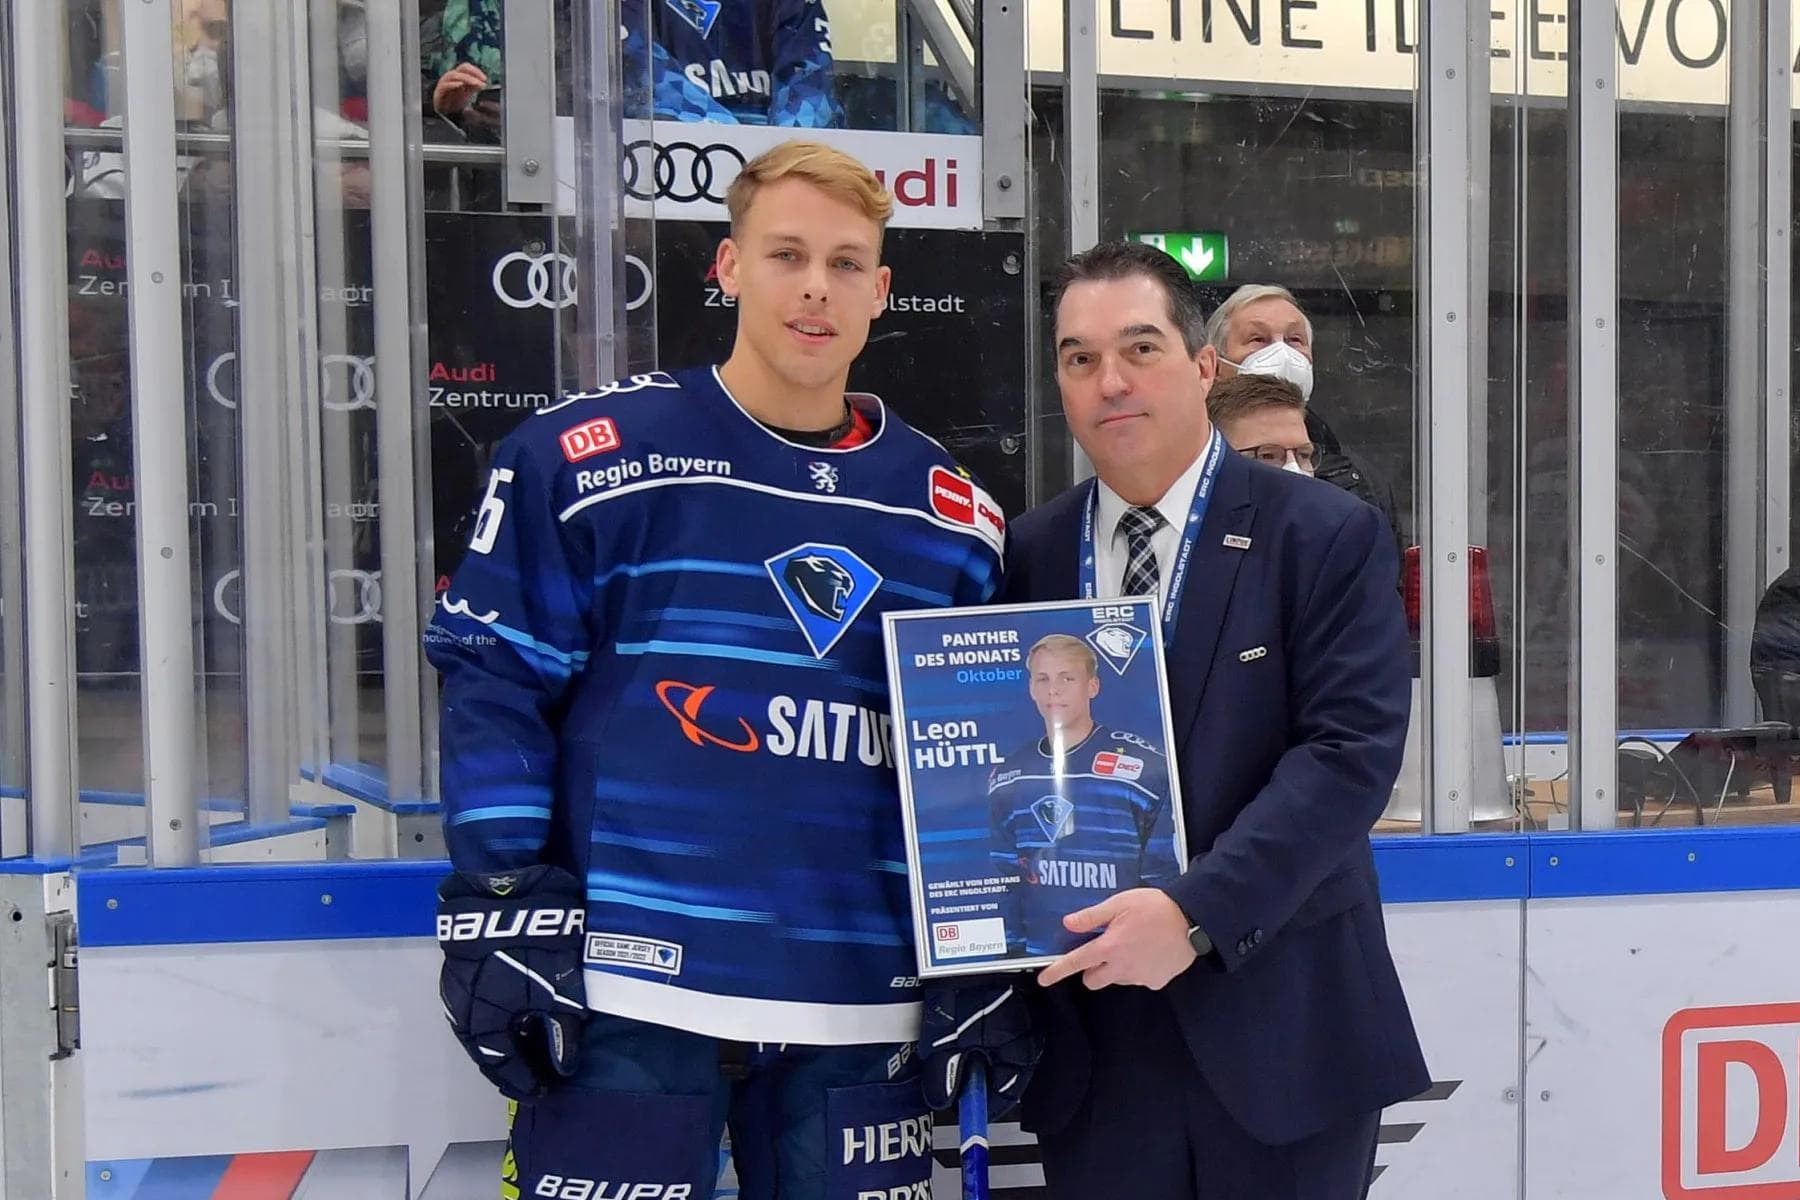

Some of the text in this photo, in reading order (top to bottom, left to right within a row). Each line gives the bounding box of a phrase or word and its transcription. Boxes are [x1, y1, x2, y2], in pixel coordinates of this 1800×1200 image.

[873, 158, 957, 207] di
[881, 293, 964, 312] lstadt
[430, 363, 495, 382] Audi
[430, 388, 549, 408] Zentrum
[564, 421, 615, 457] DB
[576, 453, 731, 494] Regio Bayern
[1092, 606, 1135, 619] ERC
[942, 630, 1019, 647] PANTHER
[914, 649, 1021, 667] DES MONATS
[956, 668, 1022, 684] Oktober
[767, 694, 896, 769] SATUR
[912, 719, 978, 741] Leon
[915, 742, 1005, 769] HÜTTL
[1038, 860, 1118, 889] SATURN
[939, 926, 957, 940] DB
[843, 1112, 934, 1165] HERR
